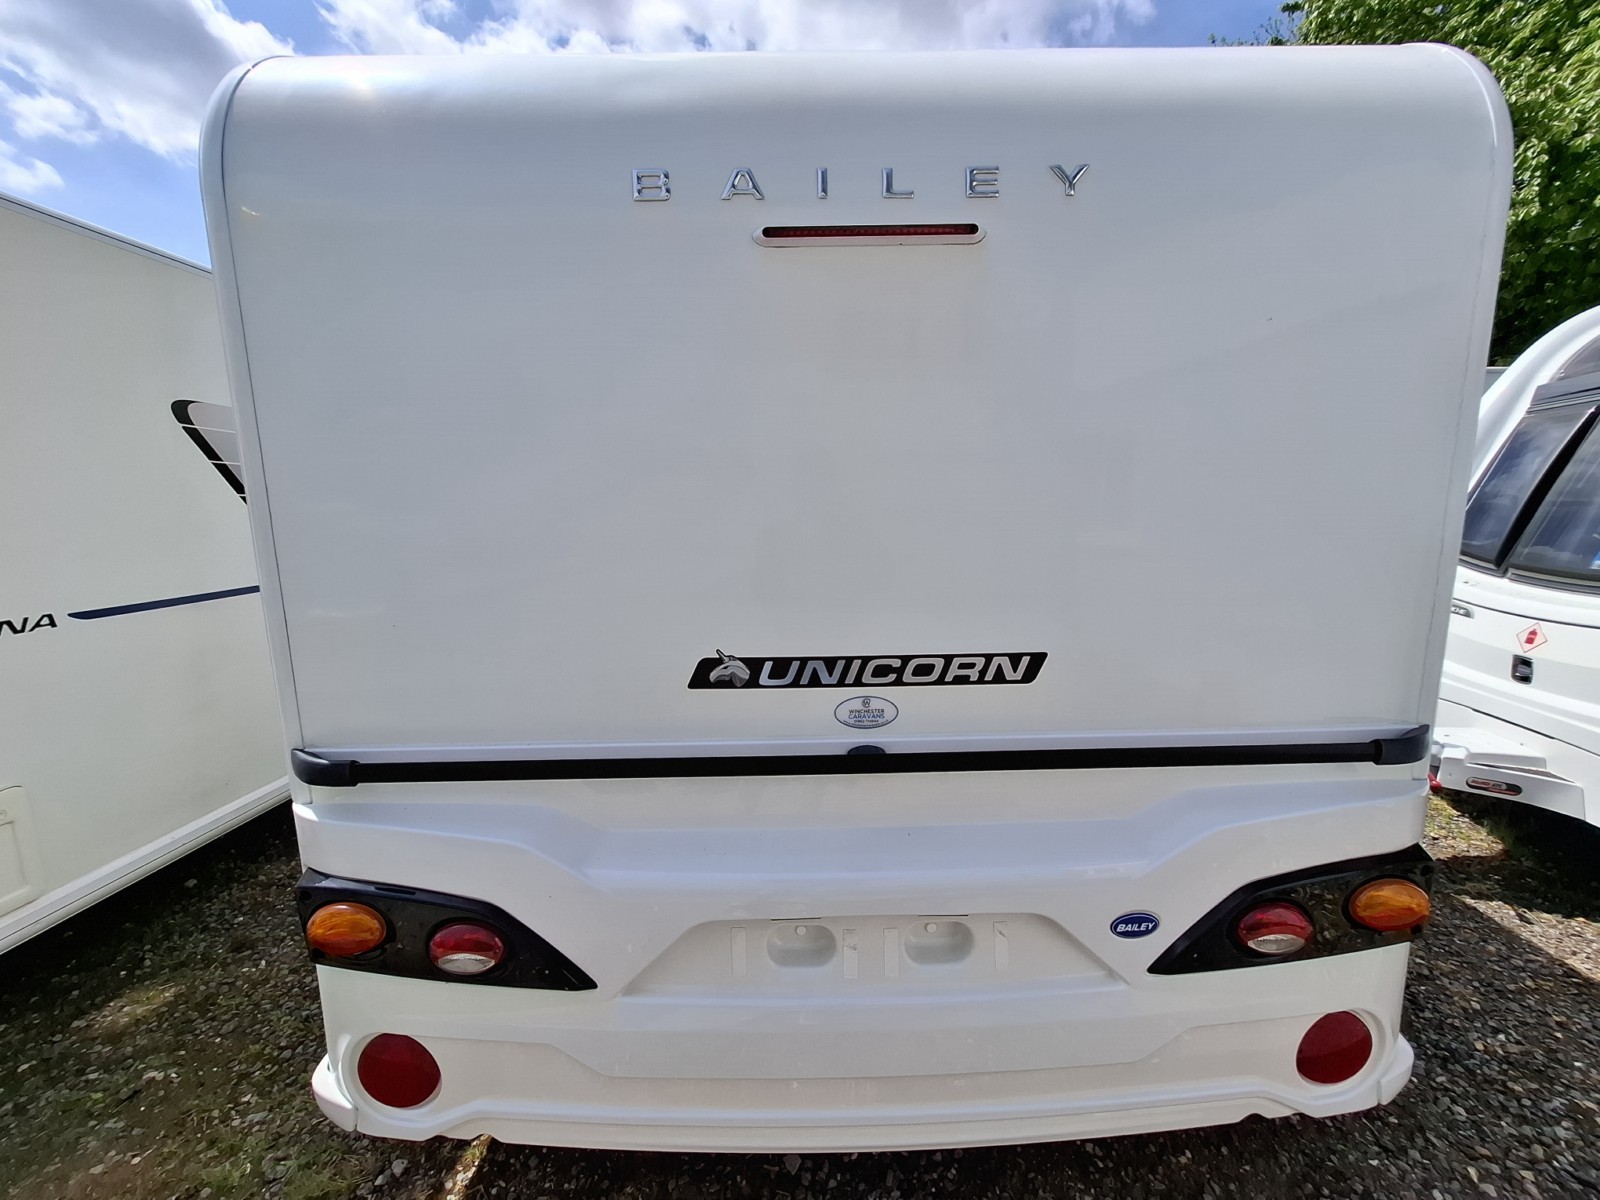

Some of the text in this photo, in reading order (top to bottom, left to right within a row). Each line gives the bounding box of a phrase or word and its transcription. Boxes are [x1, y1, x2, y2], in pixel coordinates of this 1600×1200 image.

[631, 164, 1090, 201] BAILEY
[758, 656, 1031, 686] UNICORN
[1116, 922, 1156, 932] BAILEY
